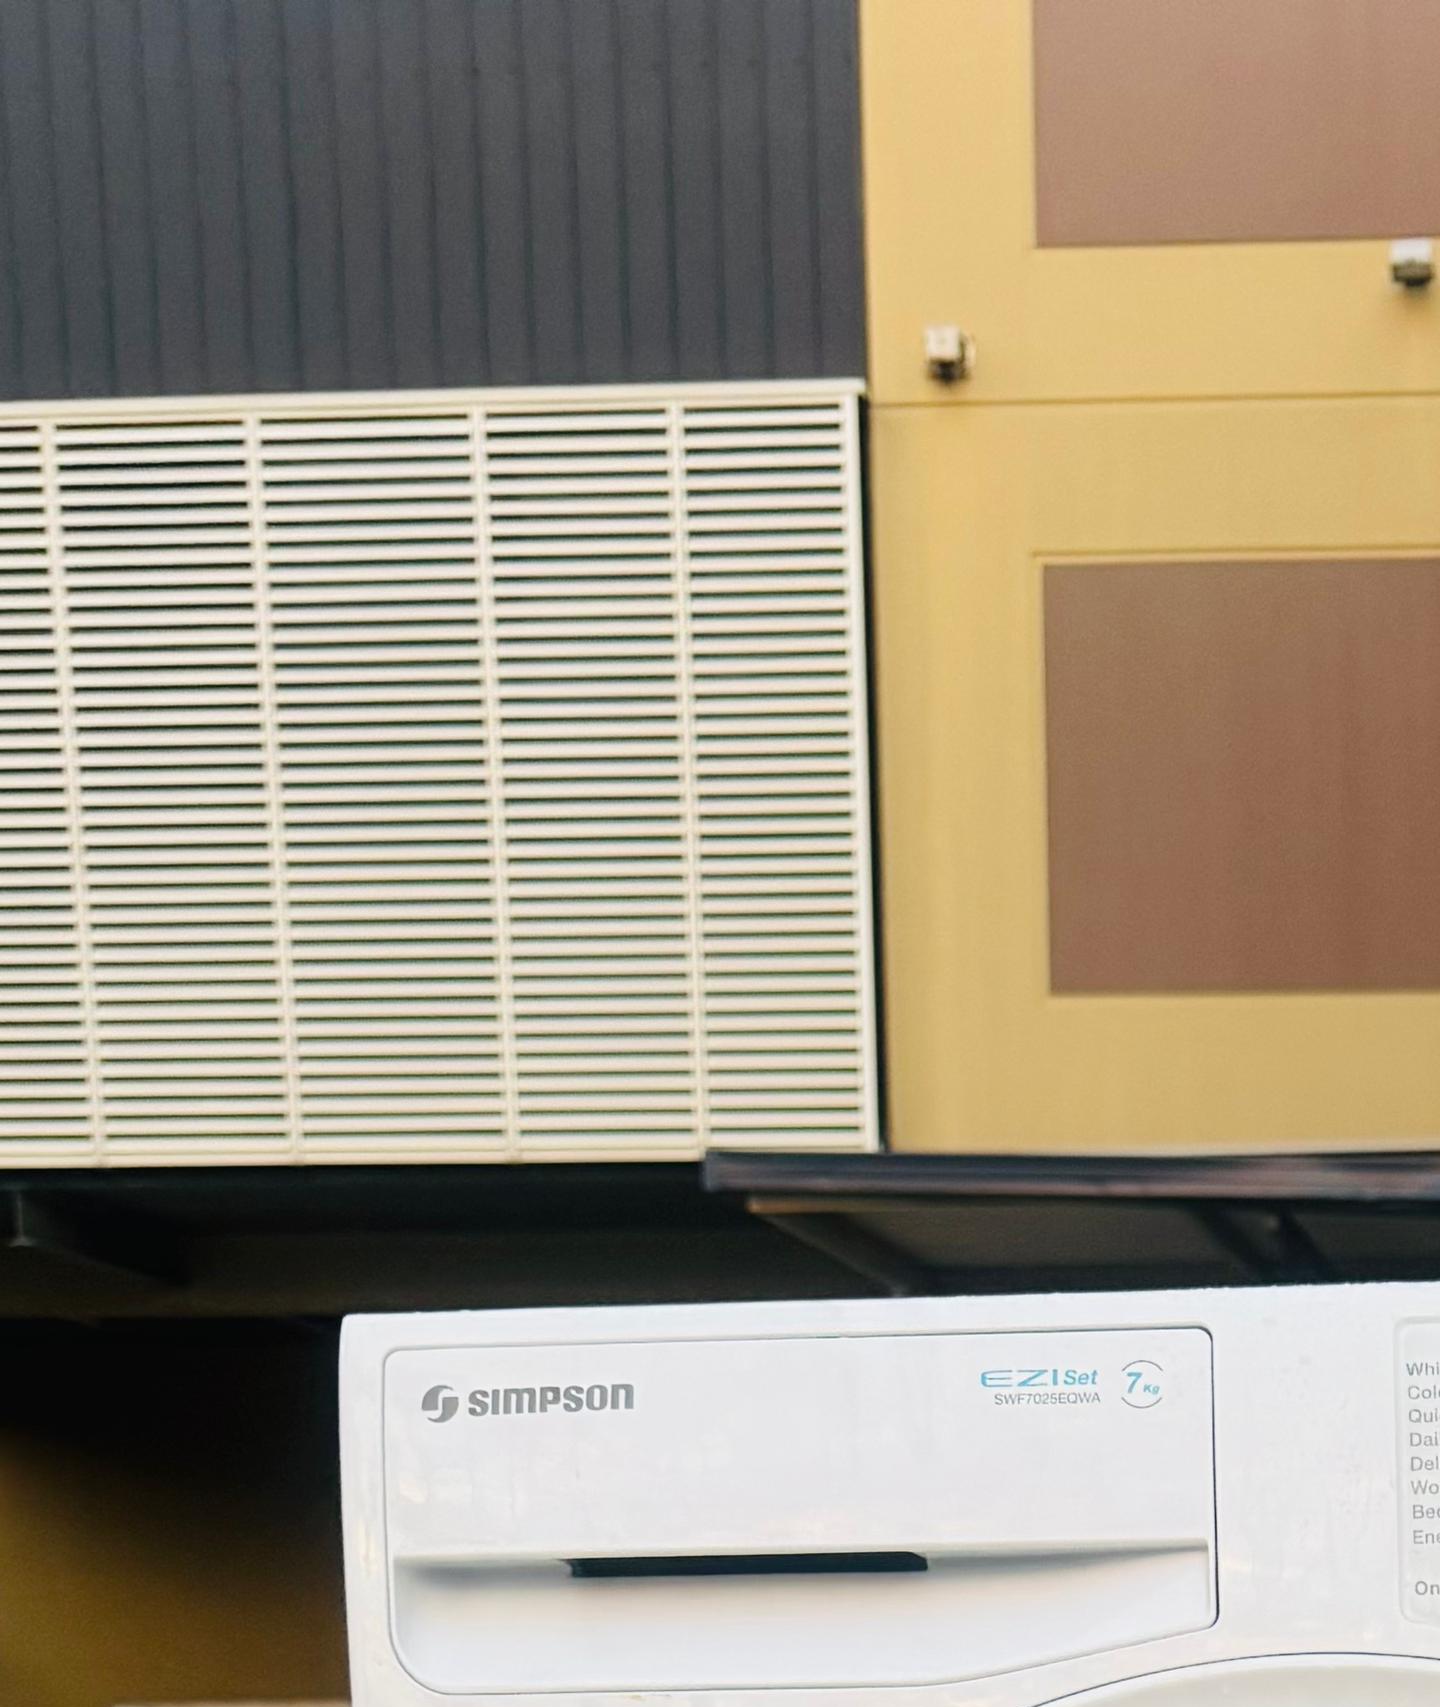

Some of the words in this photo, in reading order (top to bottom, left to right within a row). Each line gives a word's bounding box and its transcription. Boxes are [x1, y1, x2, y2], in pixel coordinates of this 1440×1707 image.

[1064, 1369, 1098, 1385] Set
[1127, 1372, 1142, 1393] 7
[468, 1384, 634, 1416] SIMPSON
[994, 1392, 1101, 1405] SWF7025EQWA
